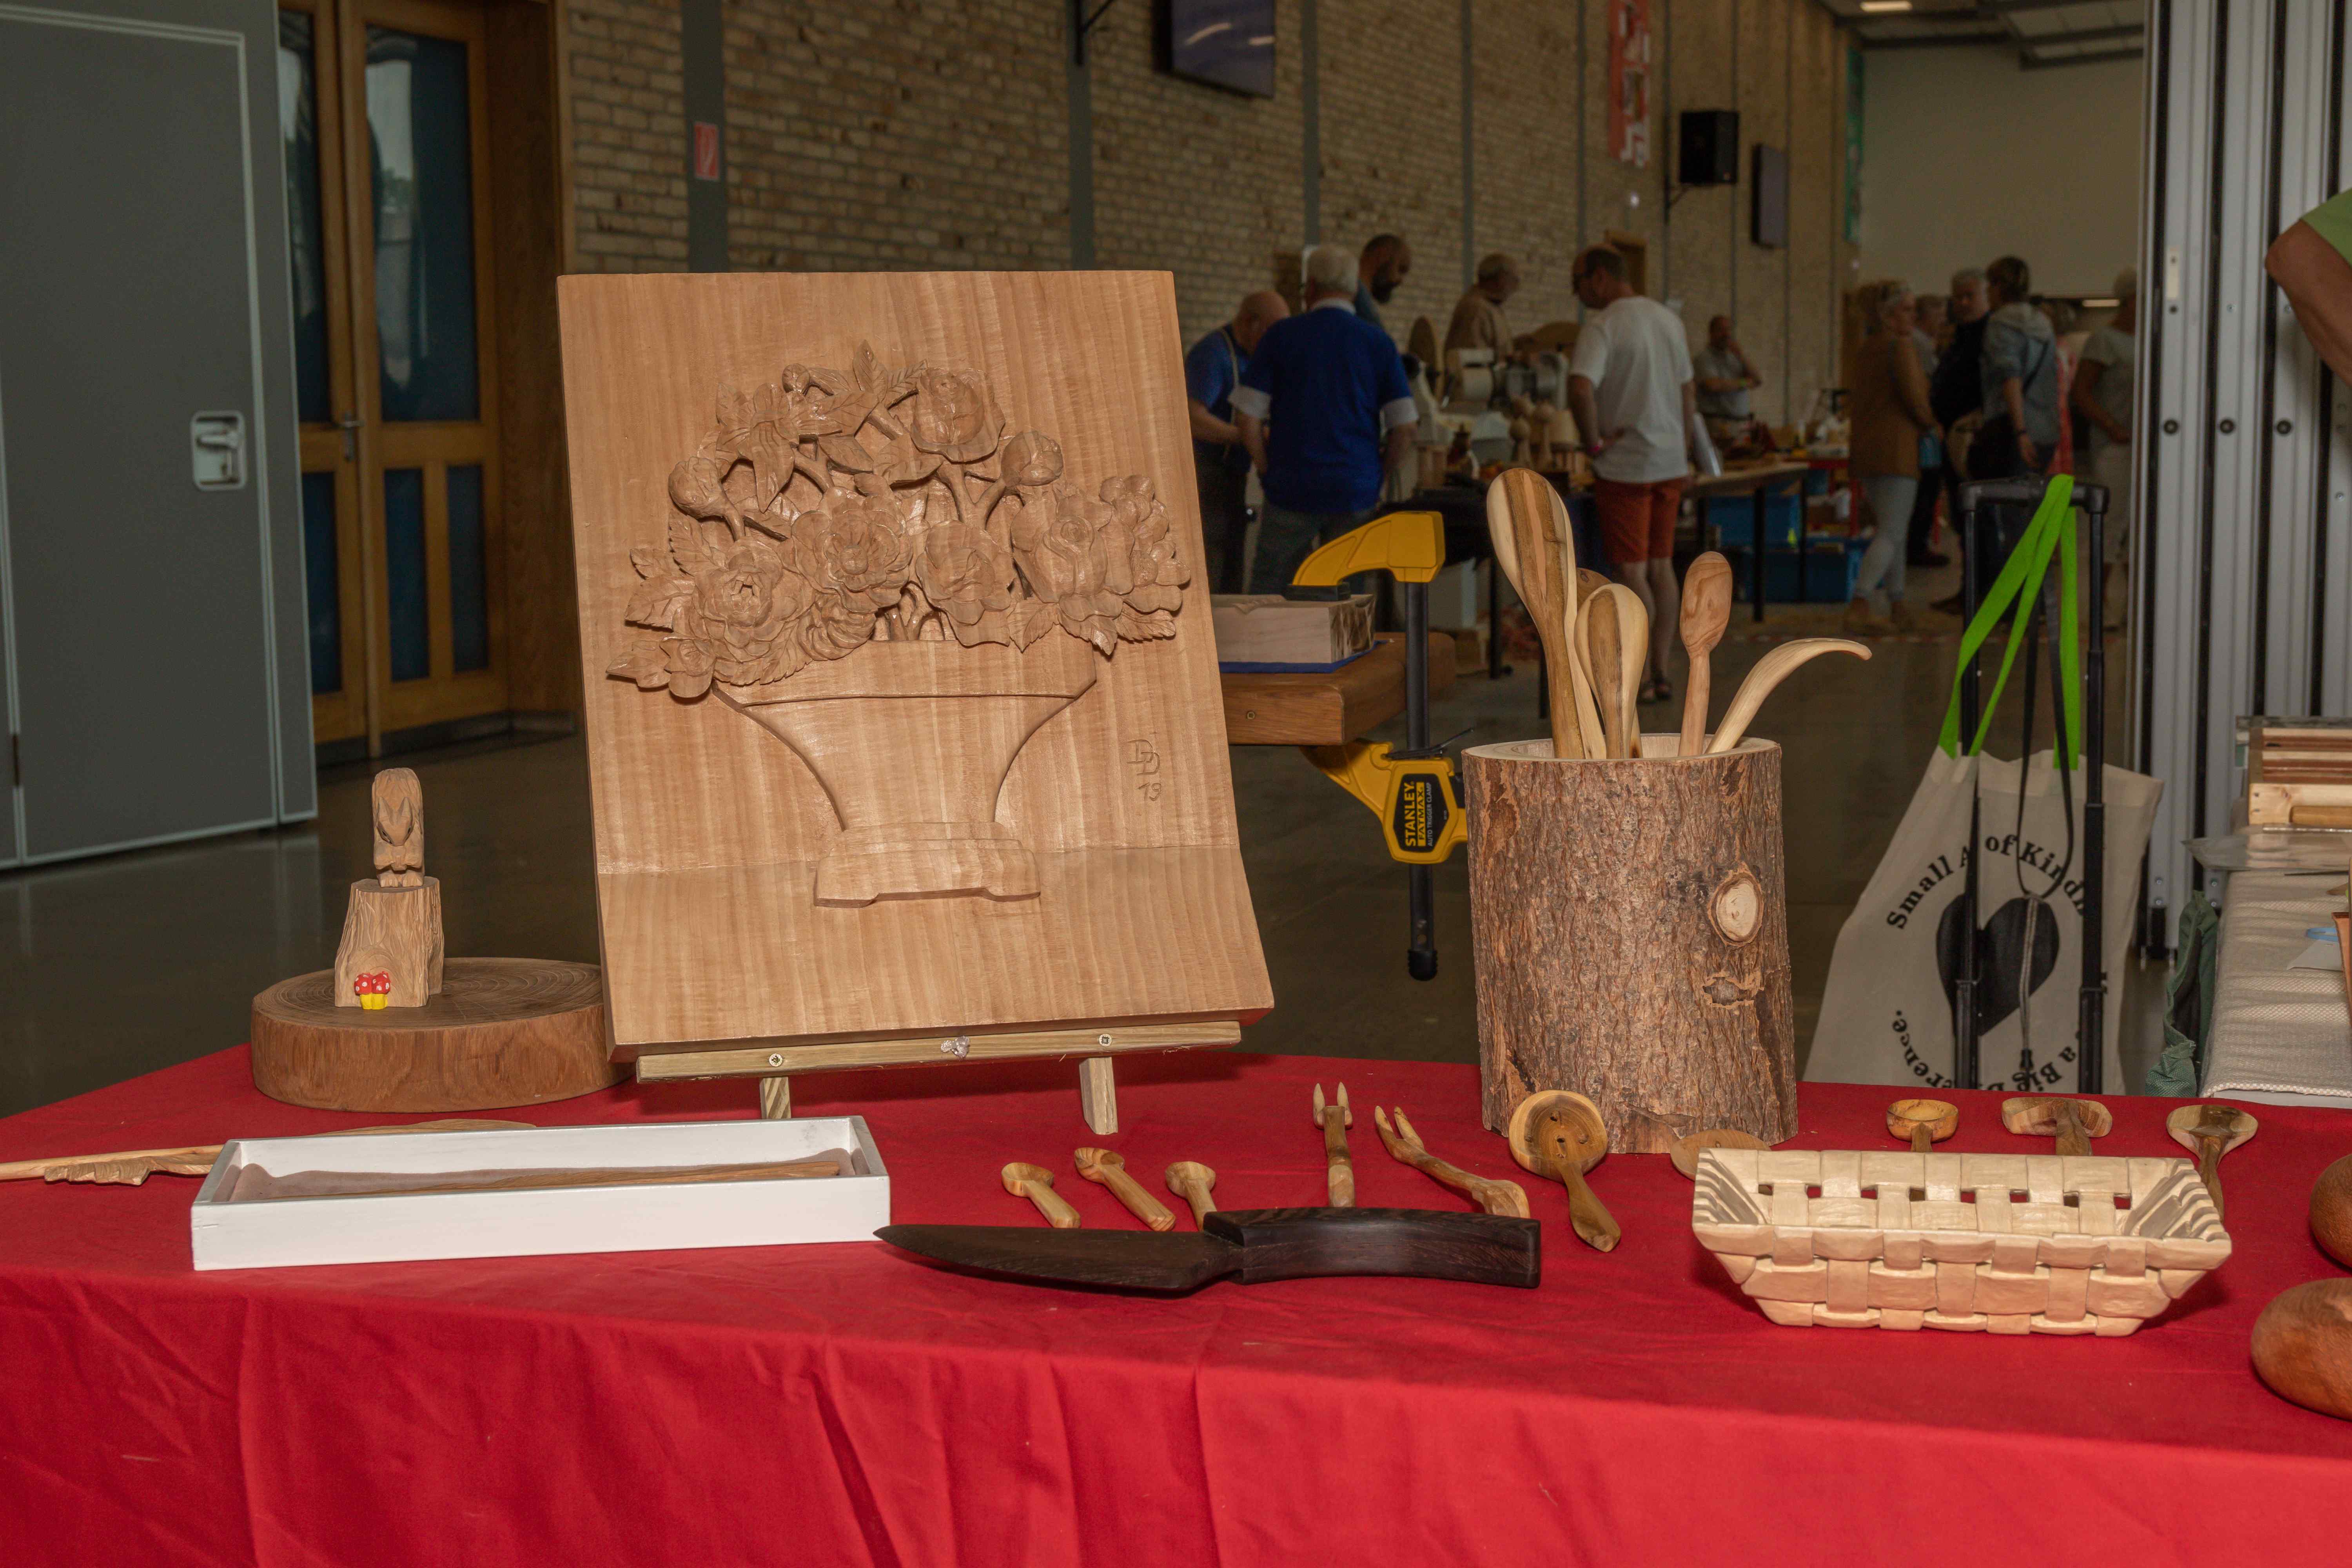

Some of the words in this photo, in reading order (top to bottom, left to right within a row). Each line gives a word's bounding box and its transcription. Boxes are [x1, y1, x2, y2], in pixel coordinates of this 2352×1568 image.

[1137, 782, 1161, 801] 19
[1404, 783, 1416, 847] STANLEY
[1887, 855, 1954, 929] Small
[1985, 834, 2017, 856] of
[2059, 1046, 2076, 1062] a
[2012, 1062, 2063, 1092] Big
